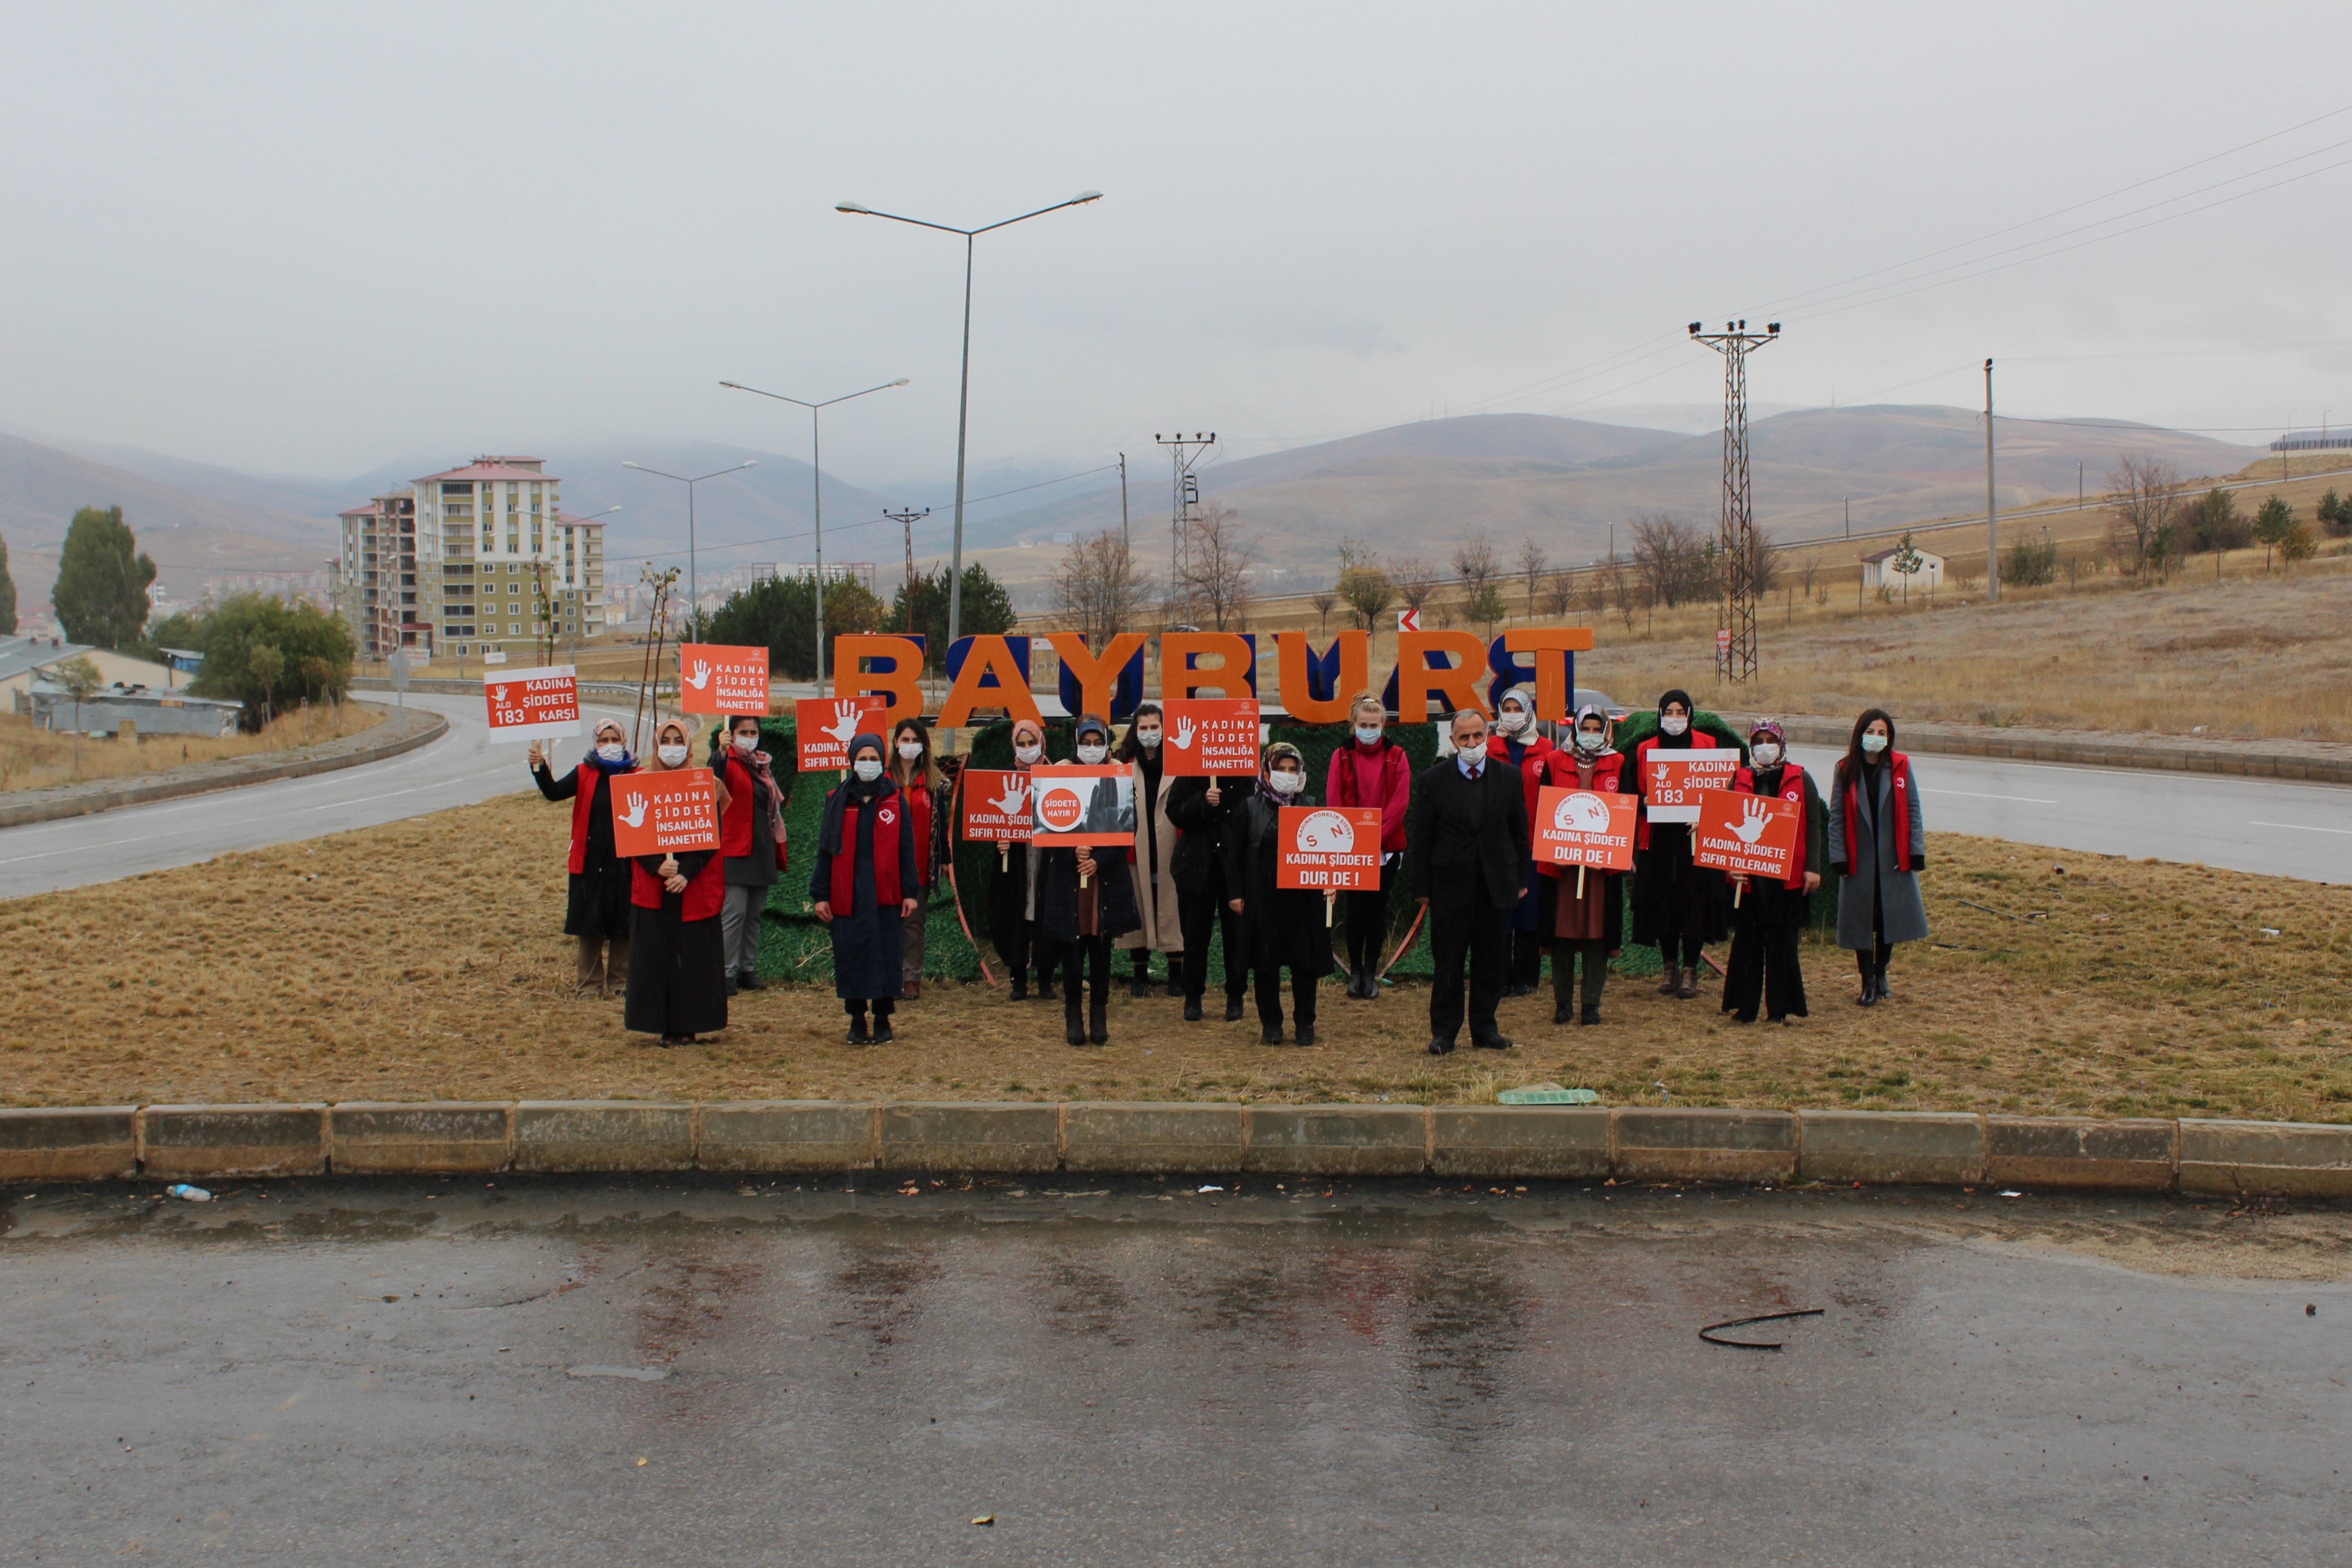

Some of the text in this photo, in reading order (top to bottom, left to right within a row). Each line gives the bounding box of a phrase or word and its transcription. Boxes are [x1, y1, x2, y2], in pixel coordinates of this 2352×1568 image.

[716, 664, 764, 674] KADINA
[526, 678, 573, 691] KADINA
[716, 675, 764, 686] ŞİDDET
[834, 628, 1593, 728] BAYBURT
[716, 686, 764, 698] İNSANLIĞA
[495, 701, 511, 710] ALO
[522, 693, 574, 709] ŞİDDETE
[716, 698, 764, 710] İHANETTİR
[496, 709, 524, 725] 183
[539, 708, 575, 721] KARŞI
[1202, 720, 1254, 729] KADINA
[1202, 731, 1254, 744] ŞİDDET
[804, 742, 840, 753] KADINA
[1202, 744, 1254, 756] İNSANLIĞA
[805, 757, 829, 768] SIFIR
[1202, 757, 1254, 769] İHANETTİR
[1689, 762, 1735, 773] KADINA
[1683, 775, 1731, 790] ŞİDDET
[654, 791, 710, 805] KADINA
[1655, 789, 1683, 804] 183
[1045, 799, 1077, 808] ŞİDDETE
[1556, 794, 1608, 821] KADINA YÖNELİK ŞİDDET
[655, 805, 711, 819] ŞİDDET
[656, 817, 713, 832] İNSANLIĞA
[969, 814, 1032, 826] KADINA ŞİDD
[1298, 812, 1352, 839] KADINA YÖNELİK ŞİDDET
[657, 831, 713, 846] İHANETTİR
[969, 828, 1032, 839] SIFIR TOLERA
[1543, 829, 1627, 847] KADINA ŞİDDETE
[1554, 846, 1582, 861] DUR
[1586, 849, 1604, 863] DE
[1702, 837, 1787, 859] KADINA ŞİDDETE
[1286, 853, 1373, 867] KADINA ŞİDDETE
[1700, 852, 1782, 874] SIFIR TOLERANS
[1300, 870, 1329, 885] DUR
[1332, 871, 1351, 886] DE
